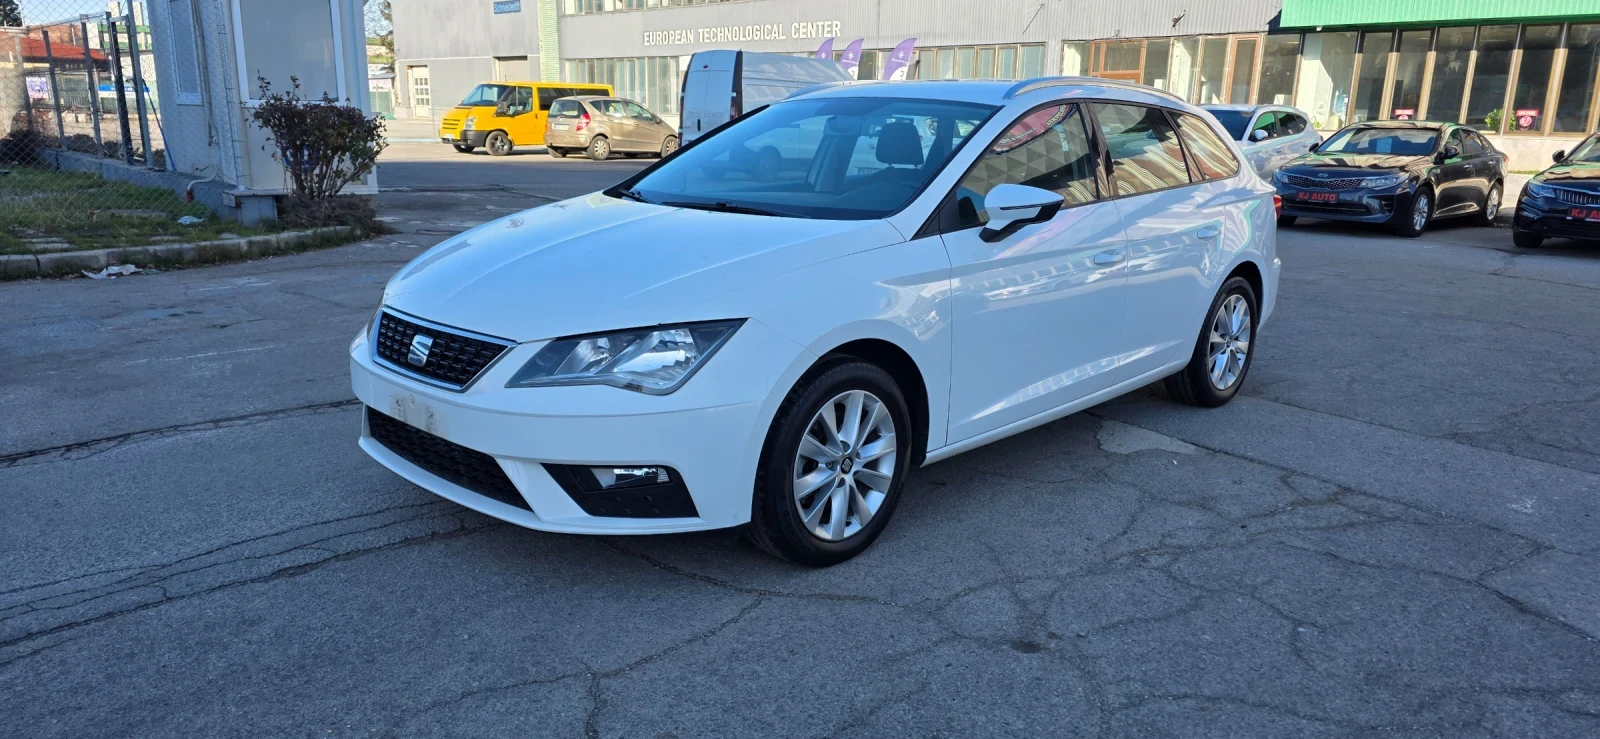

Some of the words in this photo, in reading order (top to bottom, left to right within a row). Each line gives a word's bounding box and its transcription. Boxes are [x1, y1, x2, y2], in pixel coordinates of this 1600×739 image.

[643, 30, 694, 46] EUROPEAN
[698, 25, 786, 43] TECHNOLOGICAL
[791, 20, 841, 39] CENTER
[1298, 191, 1309, 200] KJ
[1311, 193, 1336, 201] AUTO
[1571, 208, 1586, 218] KJ
